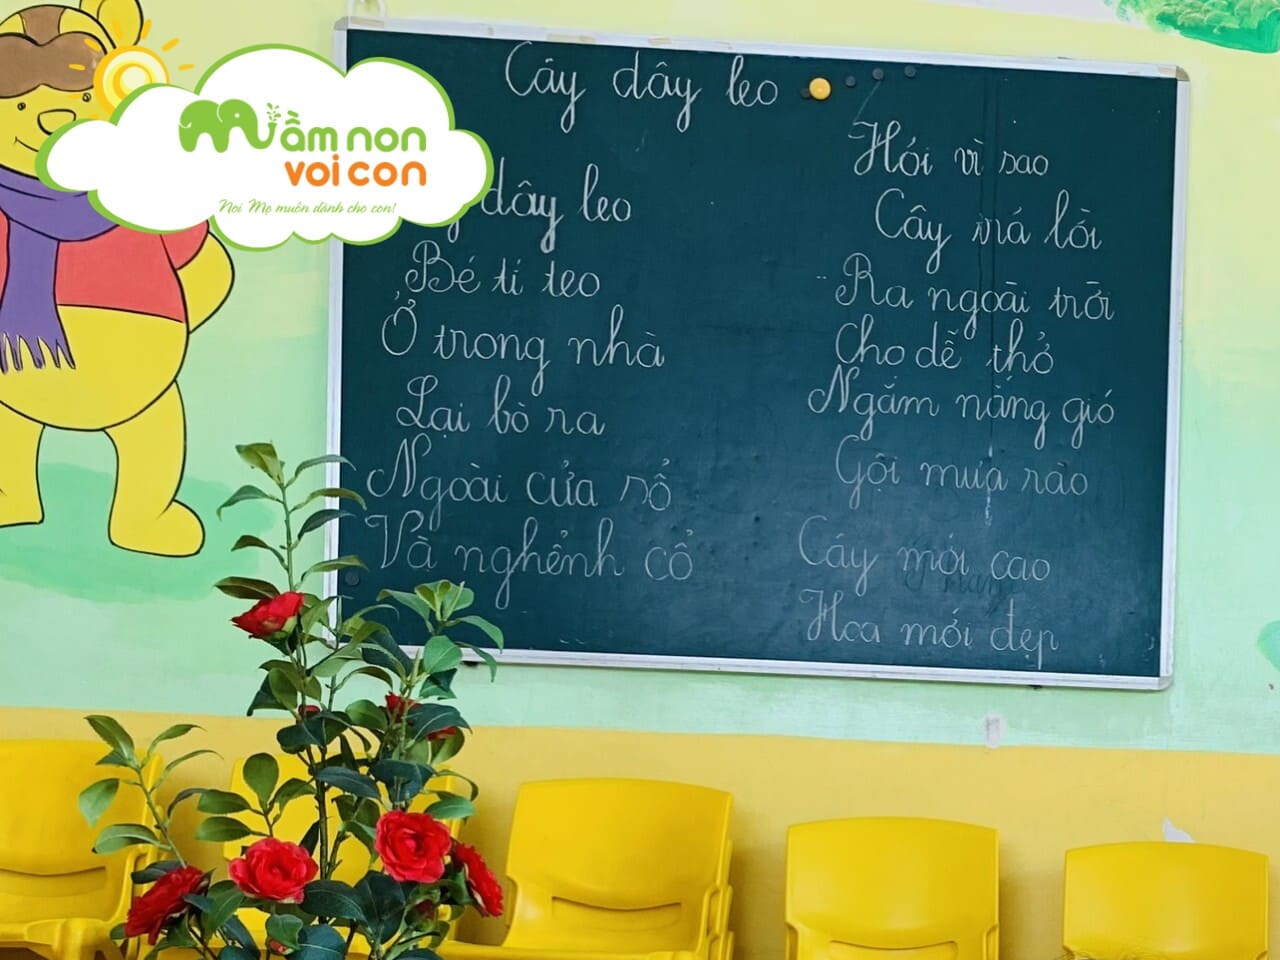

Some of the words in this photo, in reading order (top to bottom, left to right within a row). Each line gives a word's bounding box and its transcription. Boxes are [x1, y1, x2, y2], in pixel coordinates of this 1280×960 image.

[505, 41, 587, 133] Cây
[612, 50, 703, 133] dây
[726, 55, 779, 107] leo
[999, 150, 1049, 176] sao
[480, 157, 565, 254] dây
[578, 163, 632, 223] leo
[875, 188, 953, 275] Cây
[405, 240, 481, 294] Bé
[491, 256, 524, 296] tí
[540, 260, 601, 298] teo
[835, 252, 914, 308] Ra
[381, 298, 418, 356] Ở
[432, 324, 551, 397] trong
[567, 304, 666, 368] nhà
[835, 313, 906, 365] Cho
[915, 321, 962, 369] dễ
[986, 317, 1055, 375] thở
[395, 374, 471, 438] Lại
[487, 373, 530, 435] bò
[544, 406, 606, 437] ra
[1062, 388, 1116, 450] gió
[366, 432, 508, 532] Ngoài
[1020, 461, 1089, 496] rào
[364, 509, 438, 570] Và
[453, 516, 625, 610] nghểnh
[644, 528, 695, 581] cổ
[990, 549, 1051, 581] cao
[799, 588, 881, 644] Hoa
[900, 607, 974, 649] mới
[990, 597, 1060, 671] đẹp
